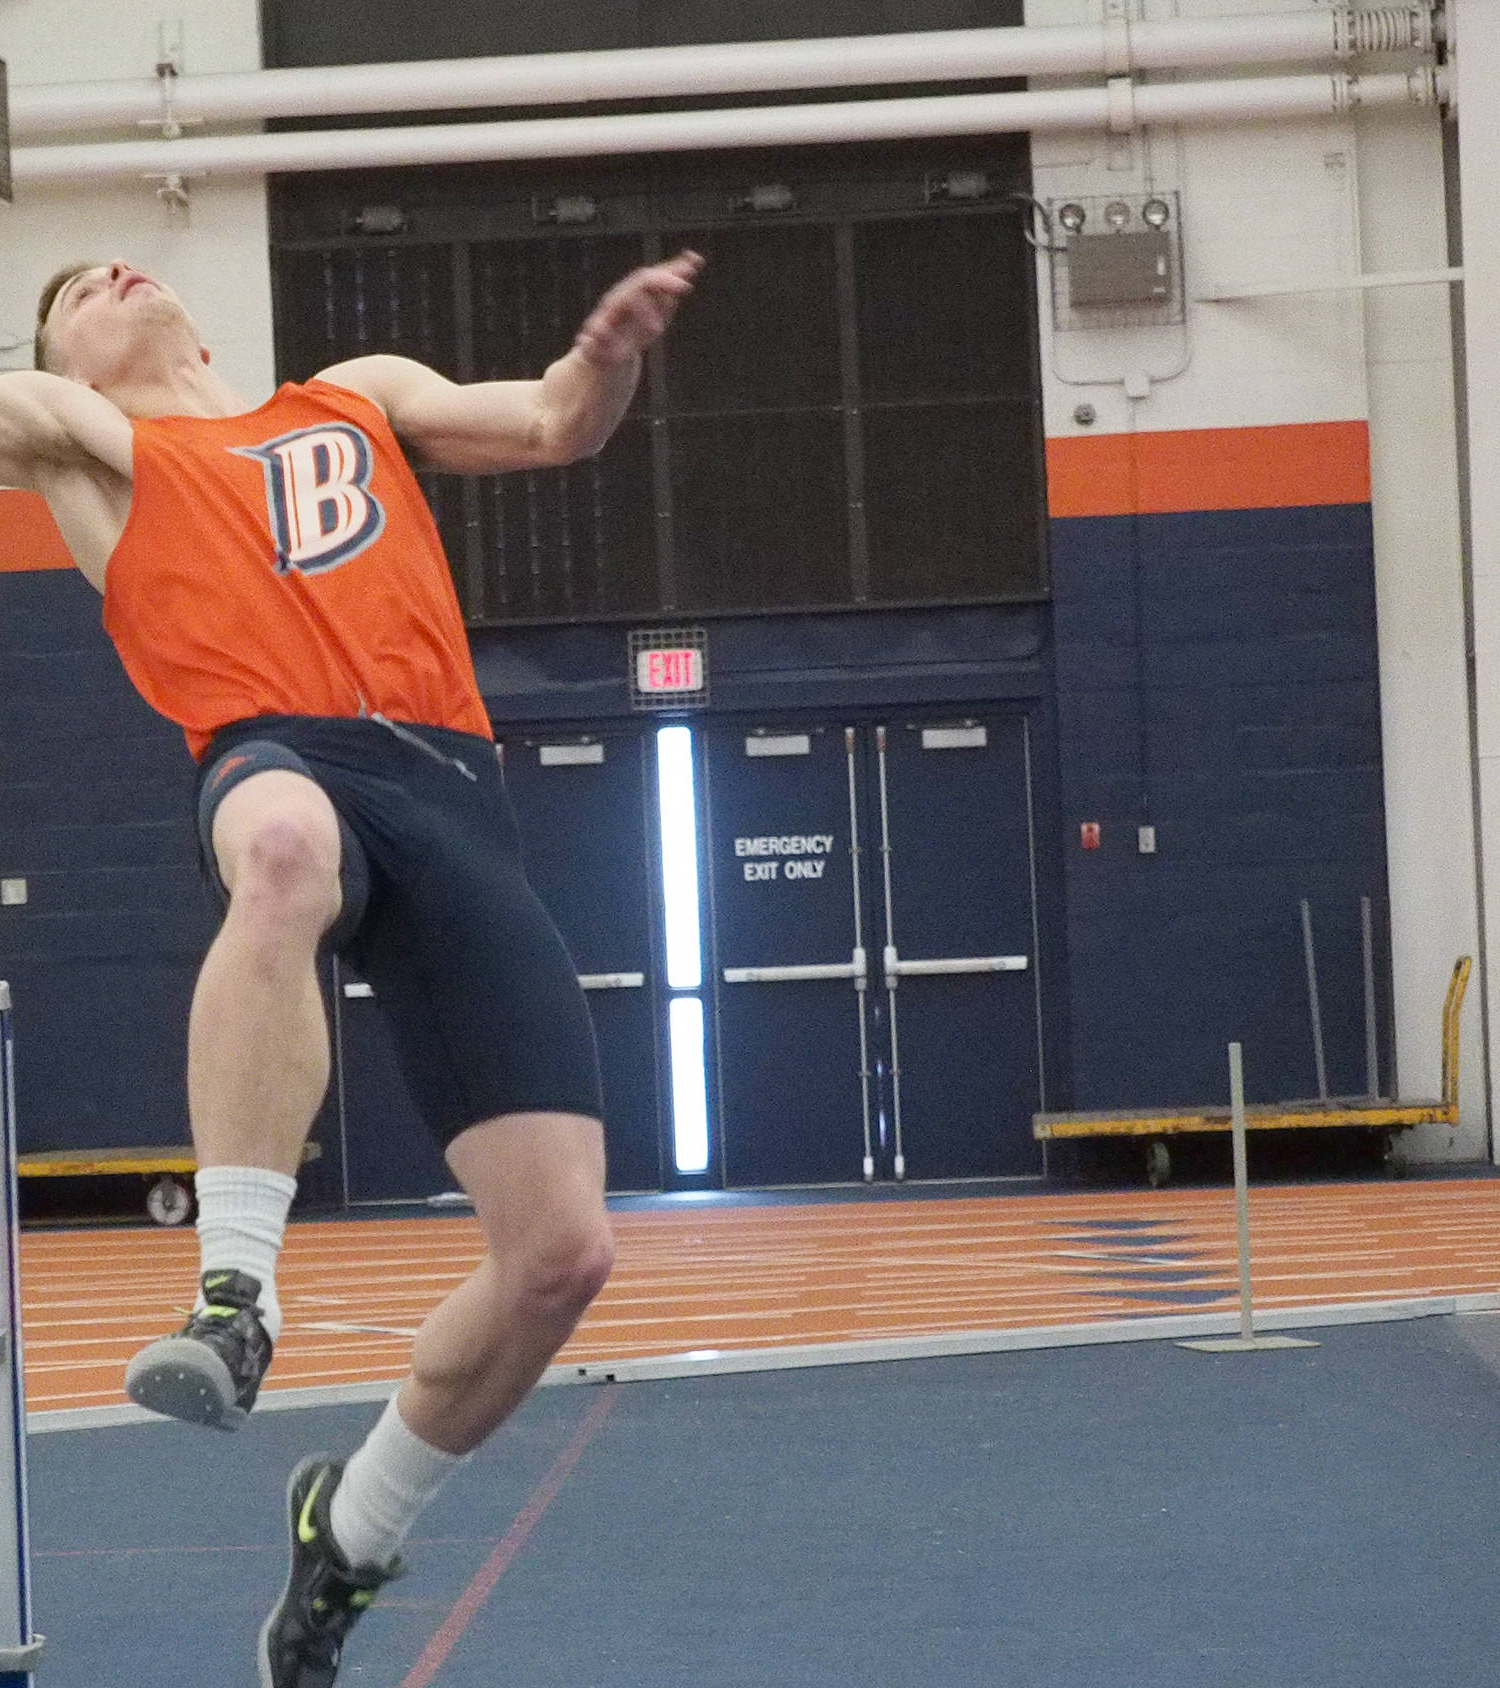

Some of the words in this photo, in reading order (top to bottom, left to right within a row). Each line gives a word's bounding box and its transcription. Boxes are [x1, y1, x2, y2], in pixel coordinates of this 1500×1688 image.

[238, 421, 386, 577] B
[649, 650, 694, 688] EXIT
[734, 834, 834, 857] EMERGENCY
[743, 861, 779, 882] EXIT
[784, 860, 825, 880] ONLY
